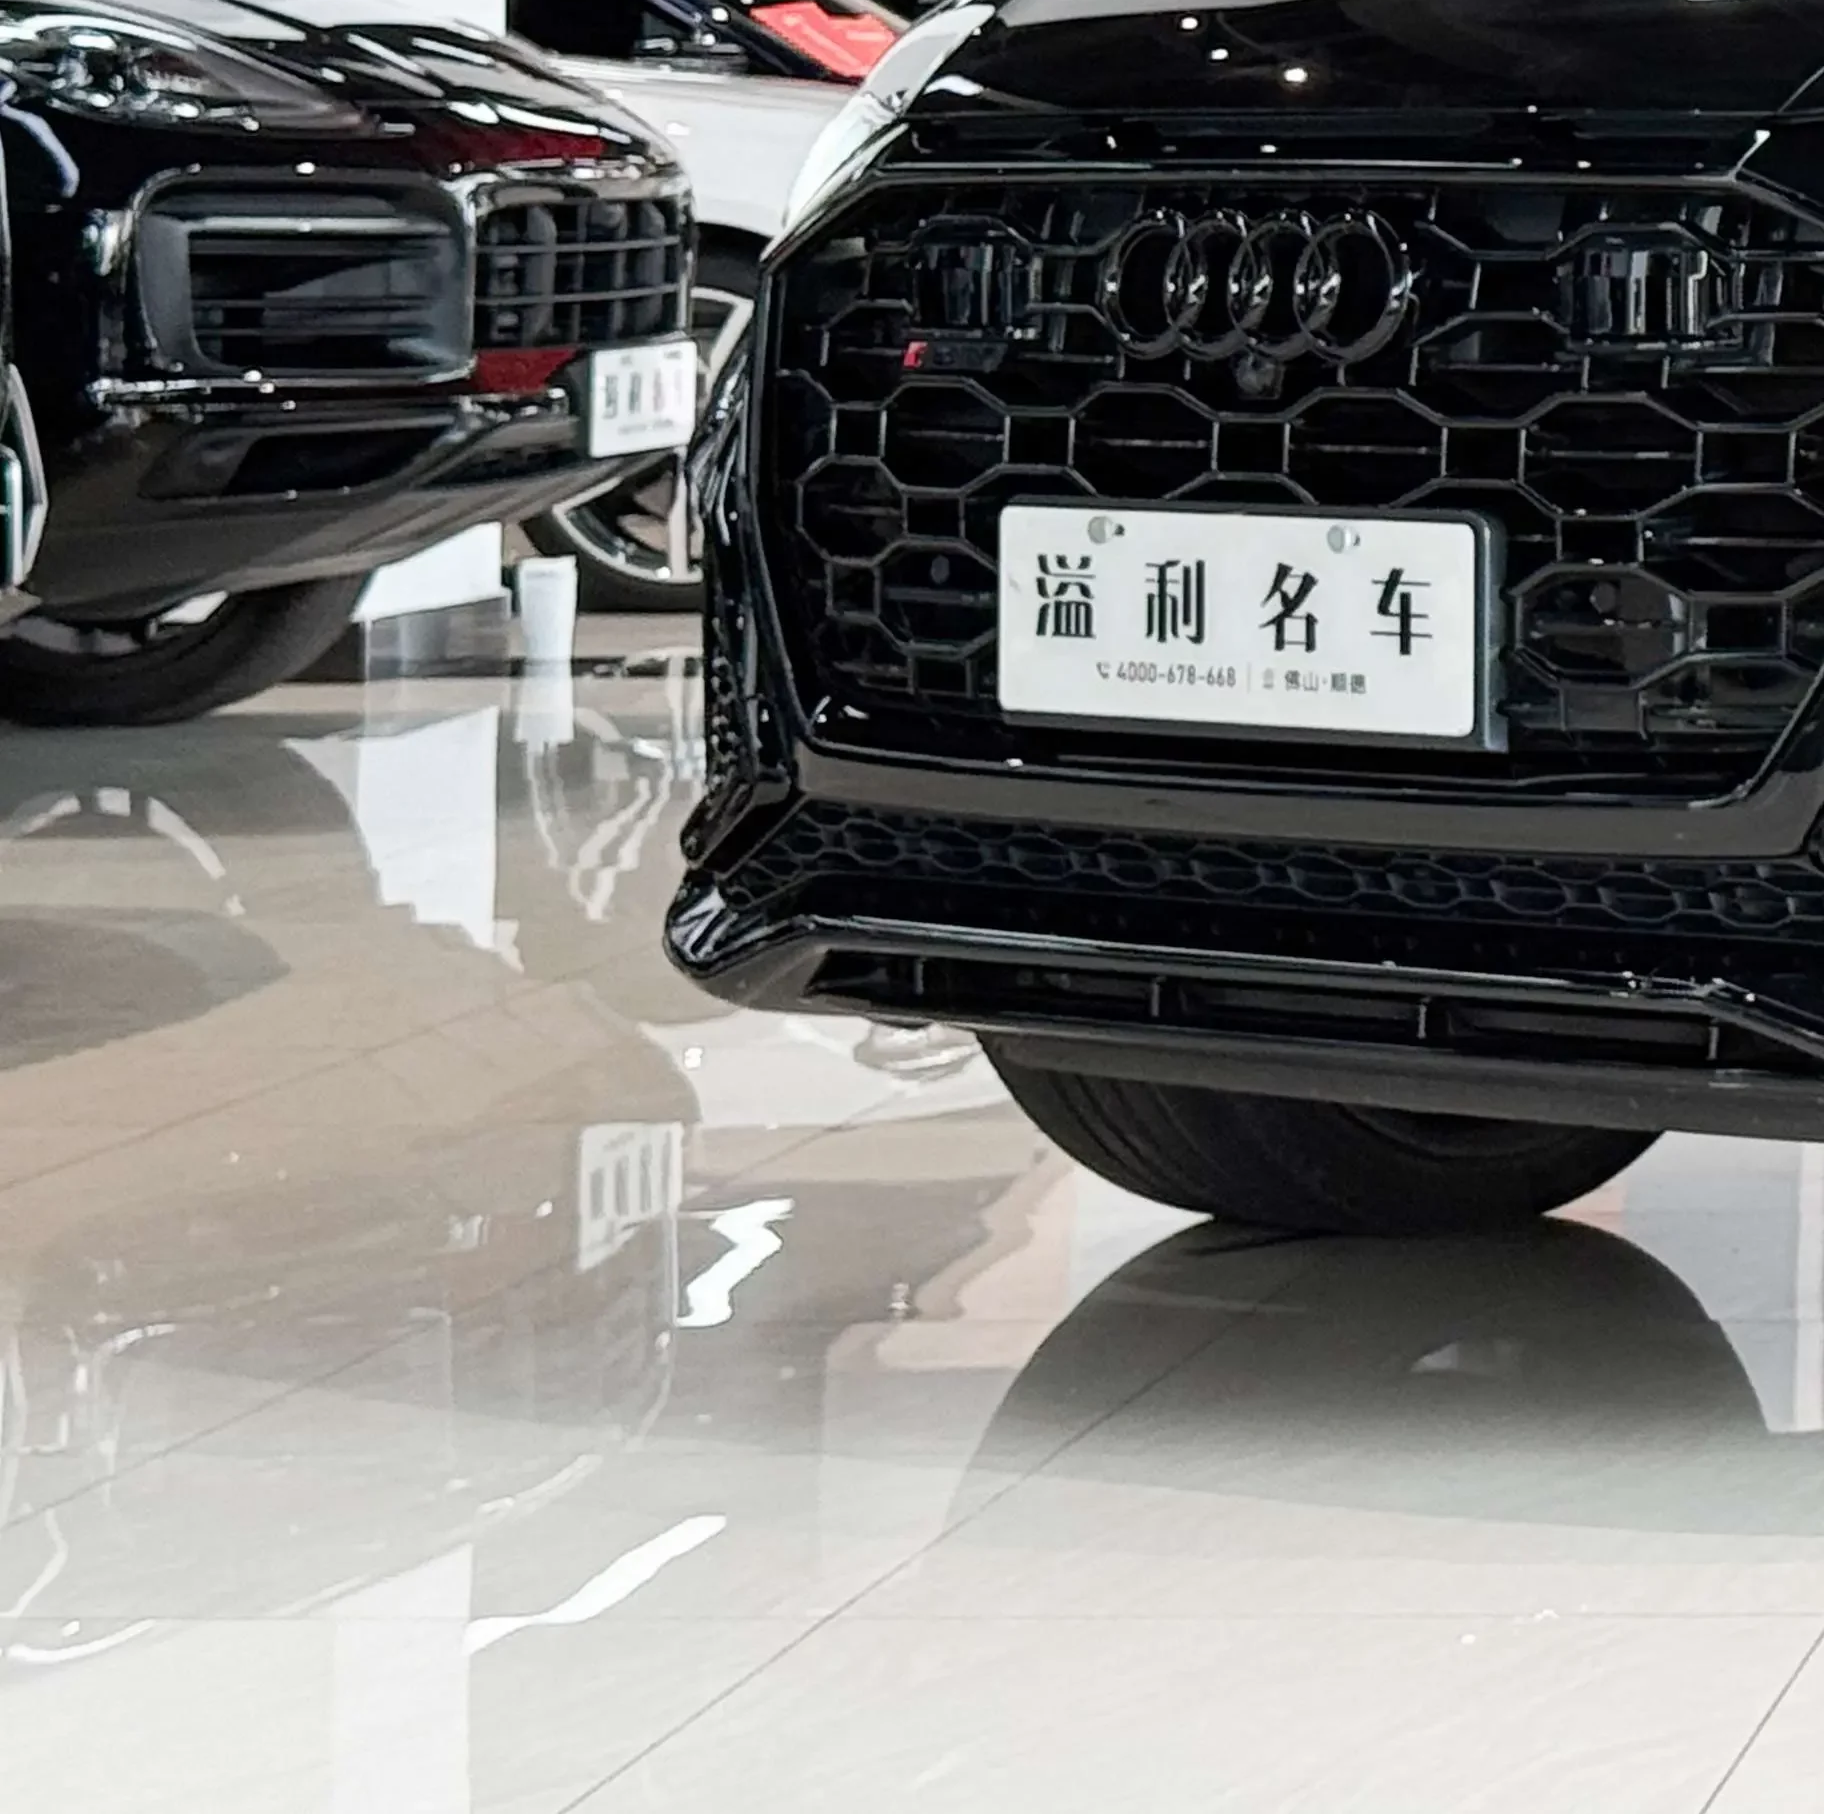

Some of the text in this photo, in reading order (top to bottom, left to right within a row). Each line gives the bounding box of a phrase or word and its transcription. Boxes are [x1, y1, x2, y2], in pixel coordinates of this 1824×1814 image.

[1035, 553, 1433, 656] 溢利名车
[1116, 660, 1237, 688] 4000-678-668
